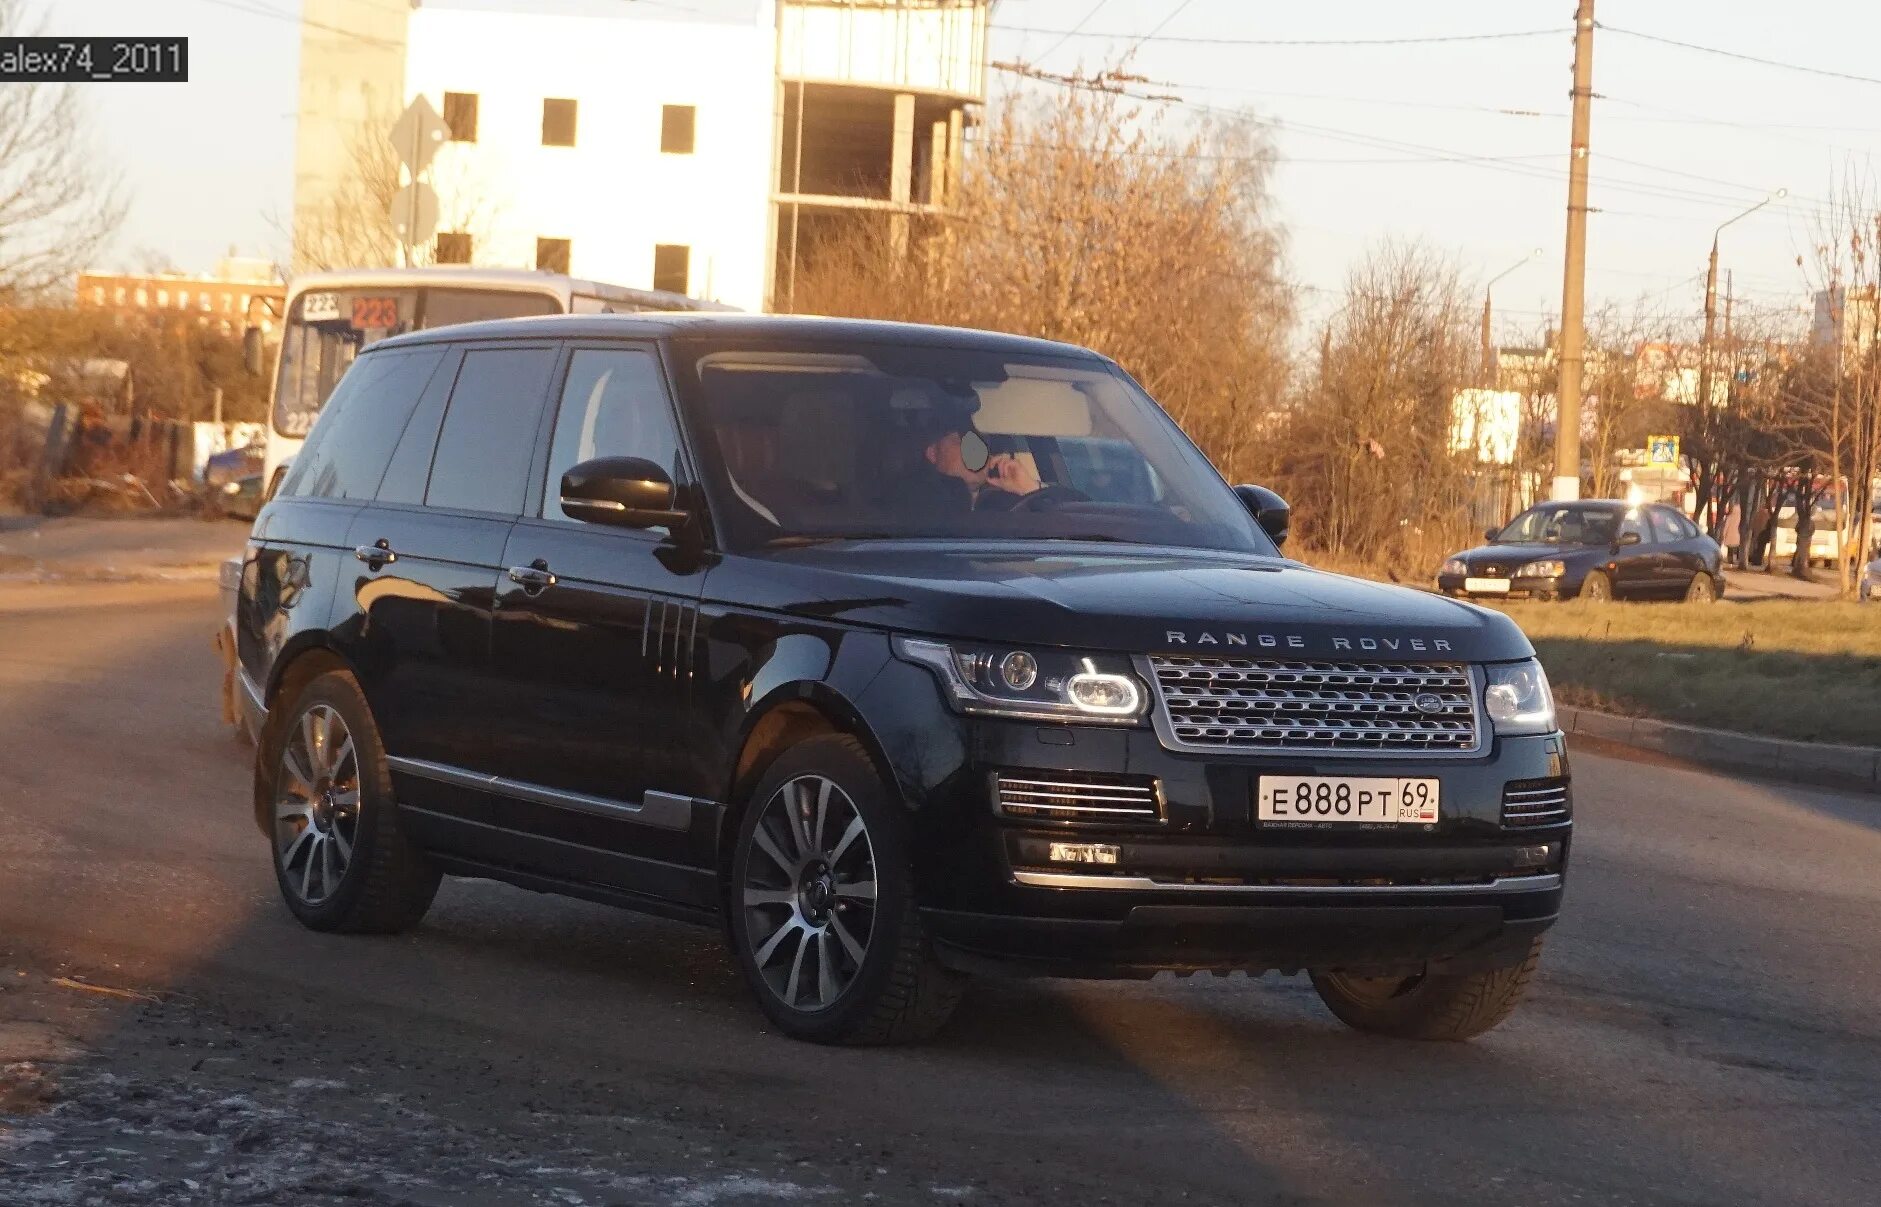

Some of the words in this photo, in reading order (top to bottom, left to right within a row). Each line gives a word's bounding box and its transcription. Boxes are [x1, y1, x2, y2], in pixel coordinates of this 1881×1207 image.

[352, 298, 396, 329] 223
[1166, 630, 1305, 648] RANGE
[1333, 637, 1452, 651] ROVER
[1402, 782, 1428, 807] 69
[1399, 809, 1419, 818] RUS
